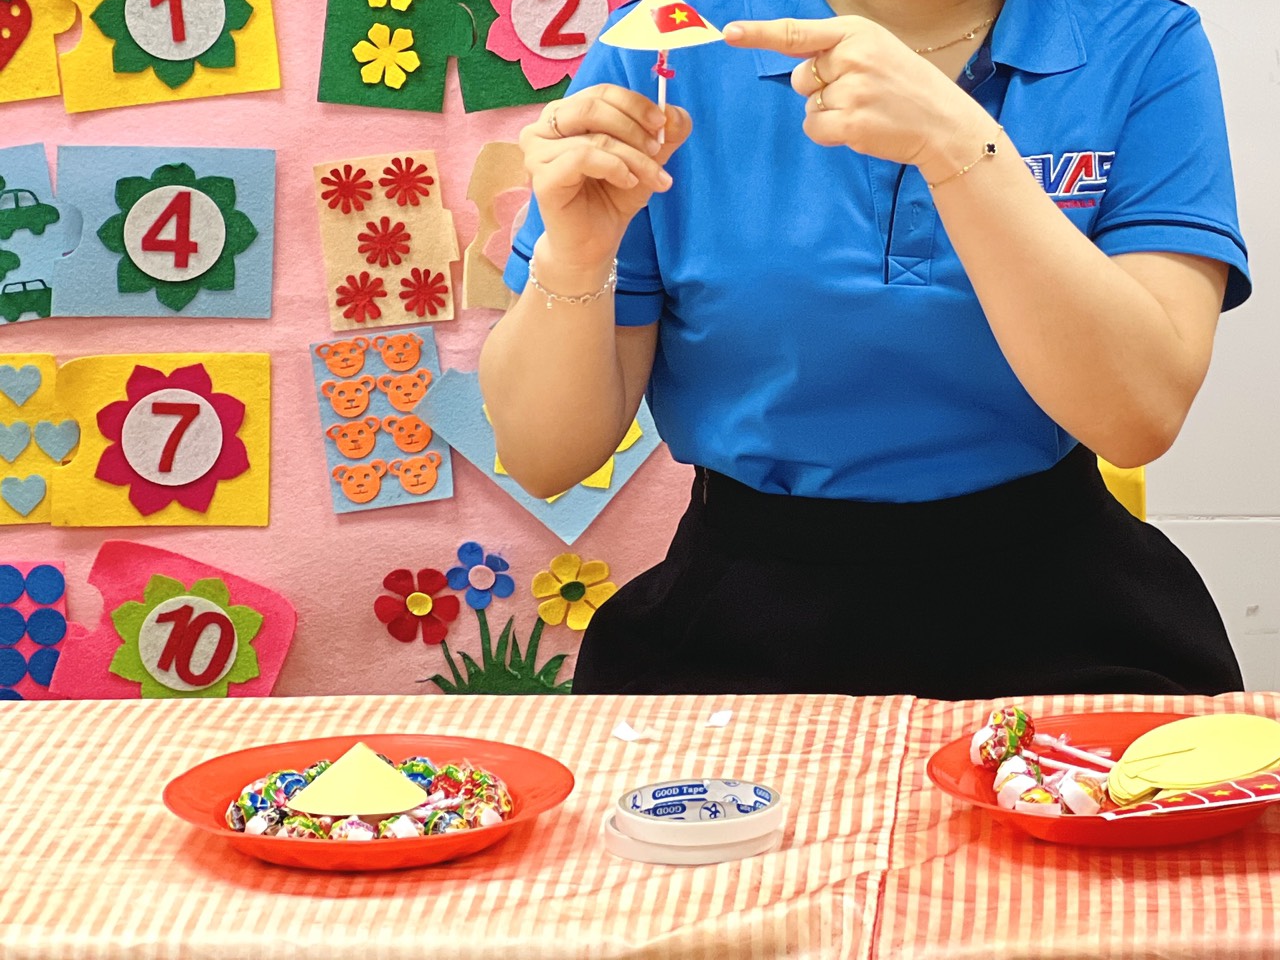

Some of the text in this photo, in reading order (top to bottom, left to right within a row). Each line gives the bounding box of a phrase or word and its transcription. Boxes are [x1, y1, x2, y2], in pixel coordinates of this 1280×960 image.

[140, 191, 198, 269] 4
[150, 402, 201, 473] 7
[155, 604, 236, 687] 10
[655, 786, 704, 798] GOOD Tape
